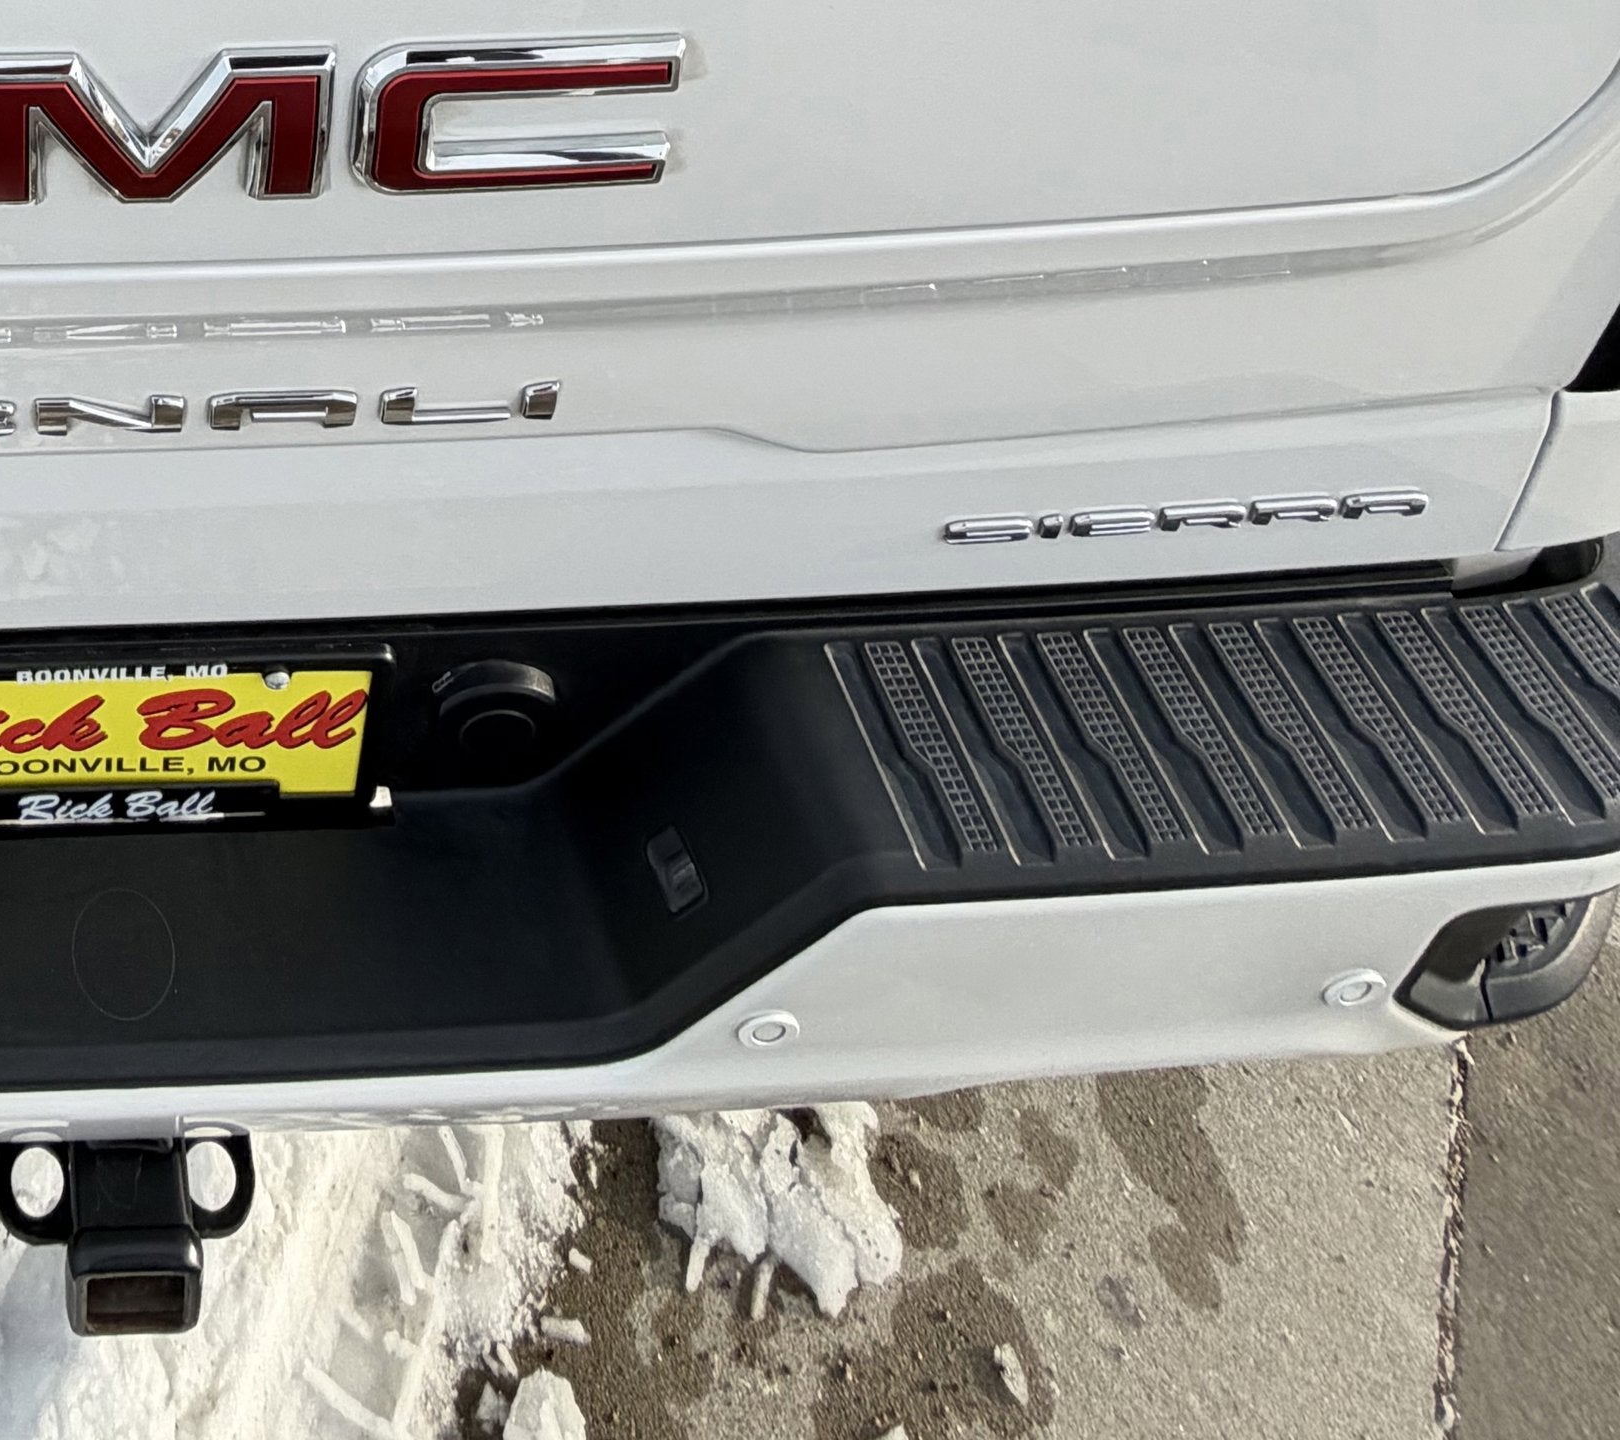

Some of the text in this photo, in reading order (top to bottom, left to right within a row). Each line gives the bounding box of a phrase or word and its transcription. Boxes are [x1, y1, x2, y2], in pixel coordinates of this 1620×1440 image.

[16, 663, 228, 685] BOONVILLE, MO
[137, 688, 370, 750] Ball
[207, 756, 266, 773] MO
[18, 791, 214, 821] Rick Ball
